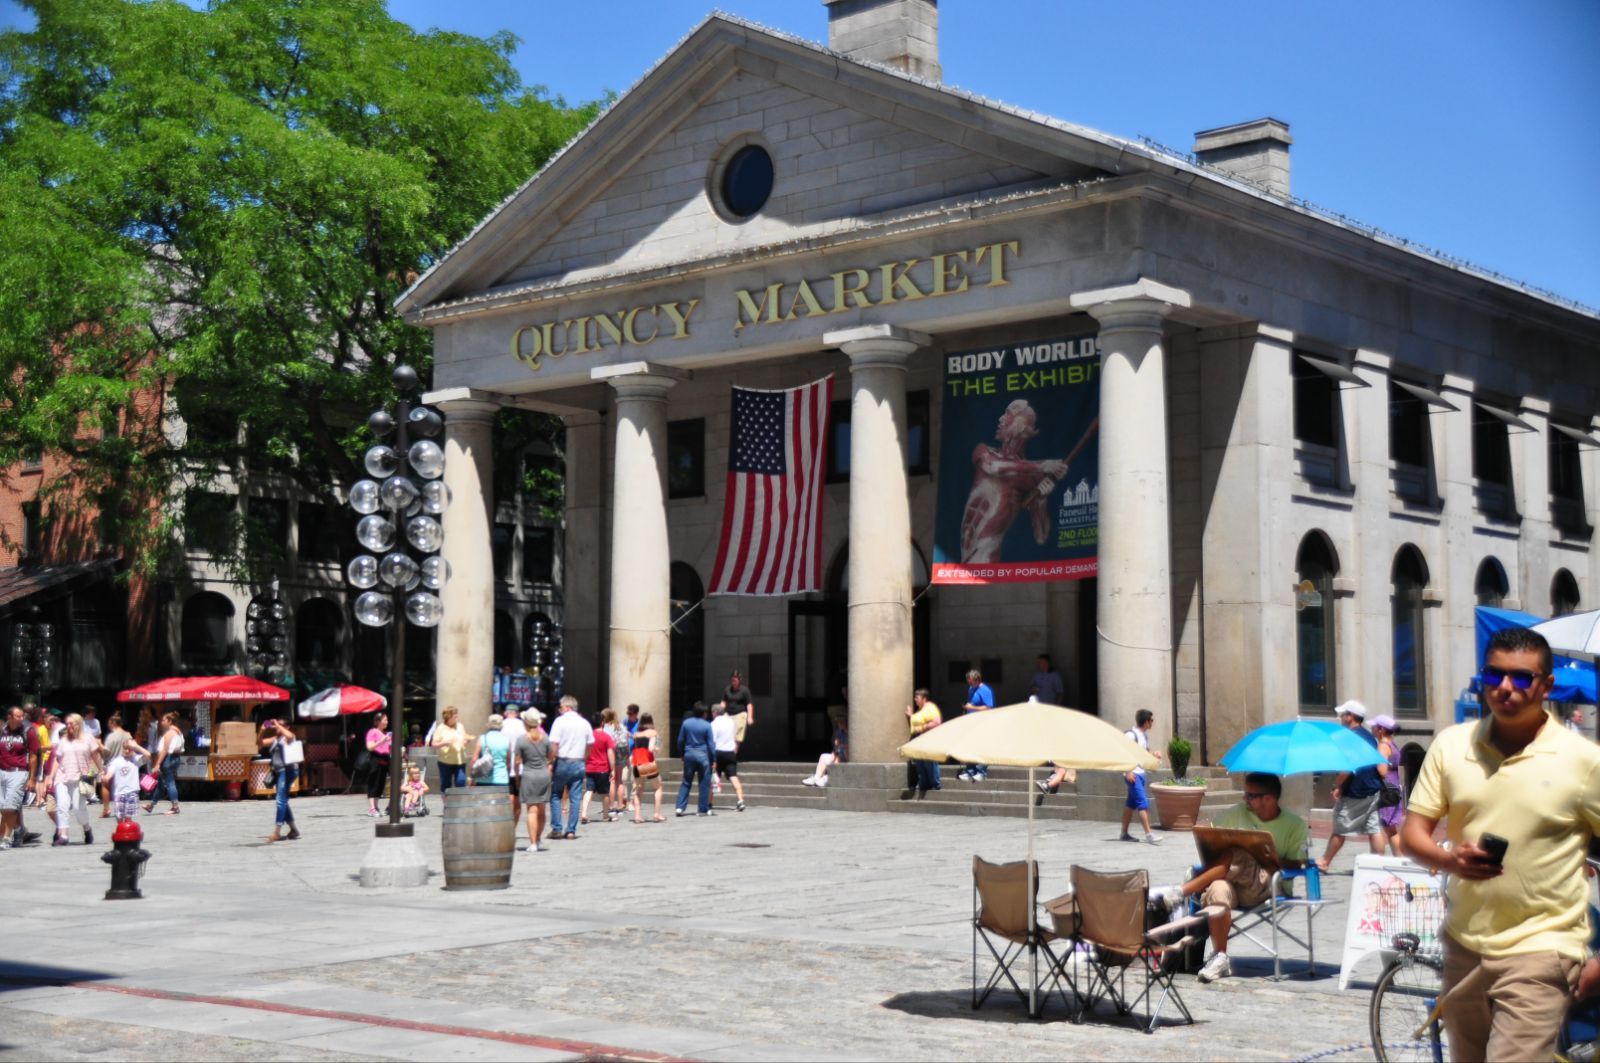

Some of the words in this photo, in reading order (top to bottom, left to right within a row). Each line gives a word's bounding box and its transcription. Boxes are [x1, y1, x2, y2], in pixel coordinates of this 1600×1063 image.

[510, 299, 699, 370] QUINCY
[735, 240, 1020, 330] MARKET
[948, 350, 1006, 374] BODY
[947, 376, 996, 397] THE
[937, 567, 994, 578] EXTENDED
[997, 568, 1012, 577] BY
[1015, 566, 1063, 577] POPULAR
[203, 690, 218, 699] New
[219, 690, 244, 699] England
